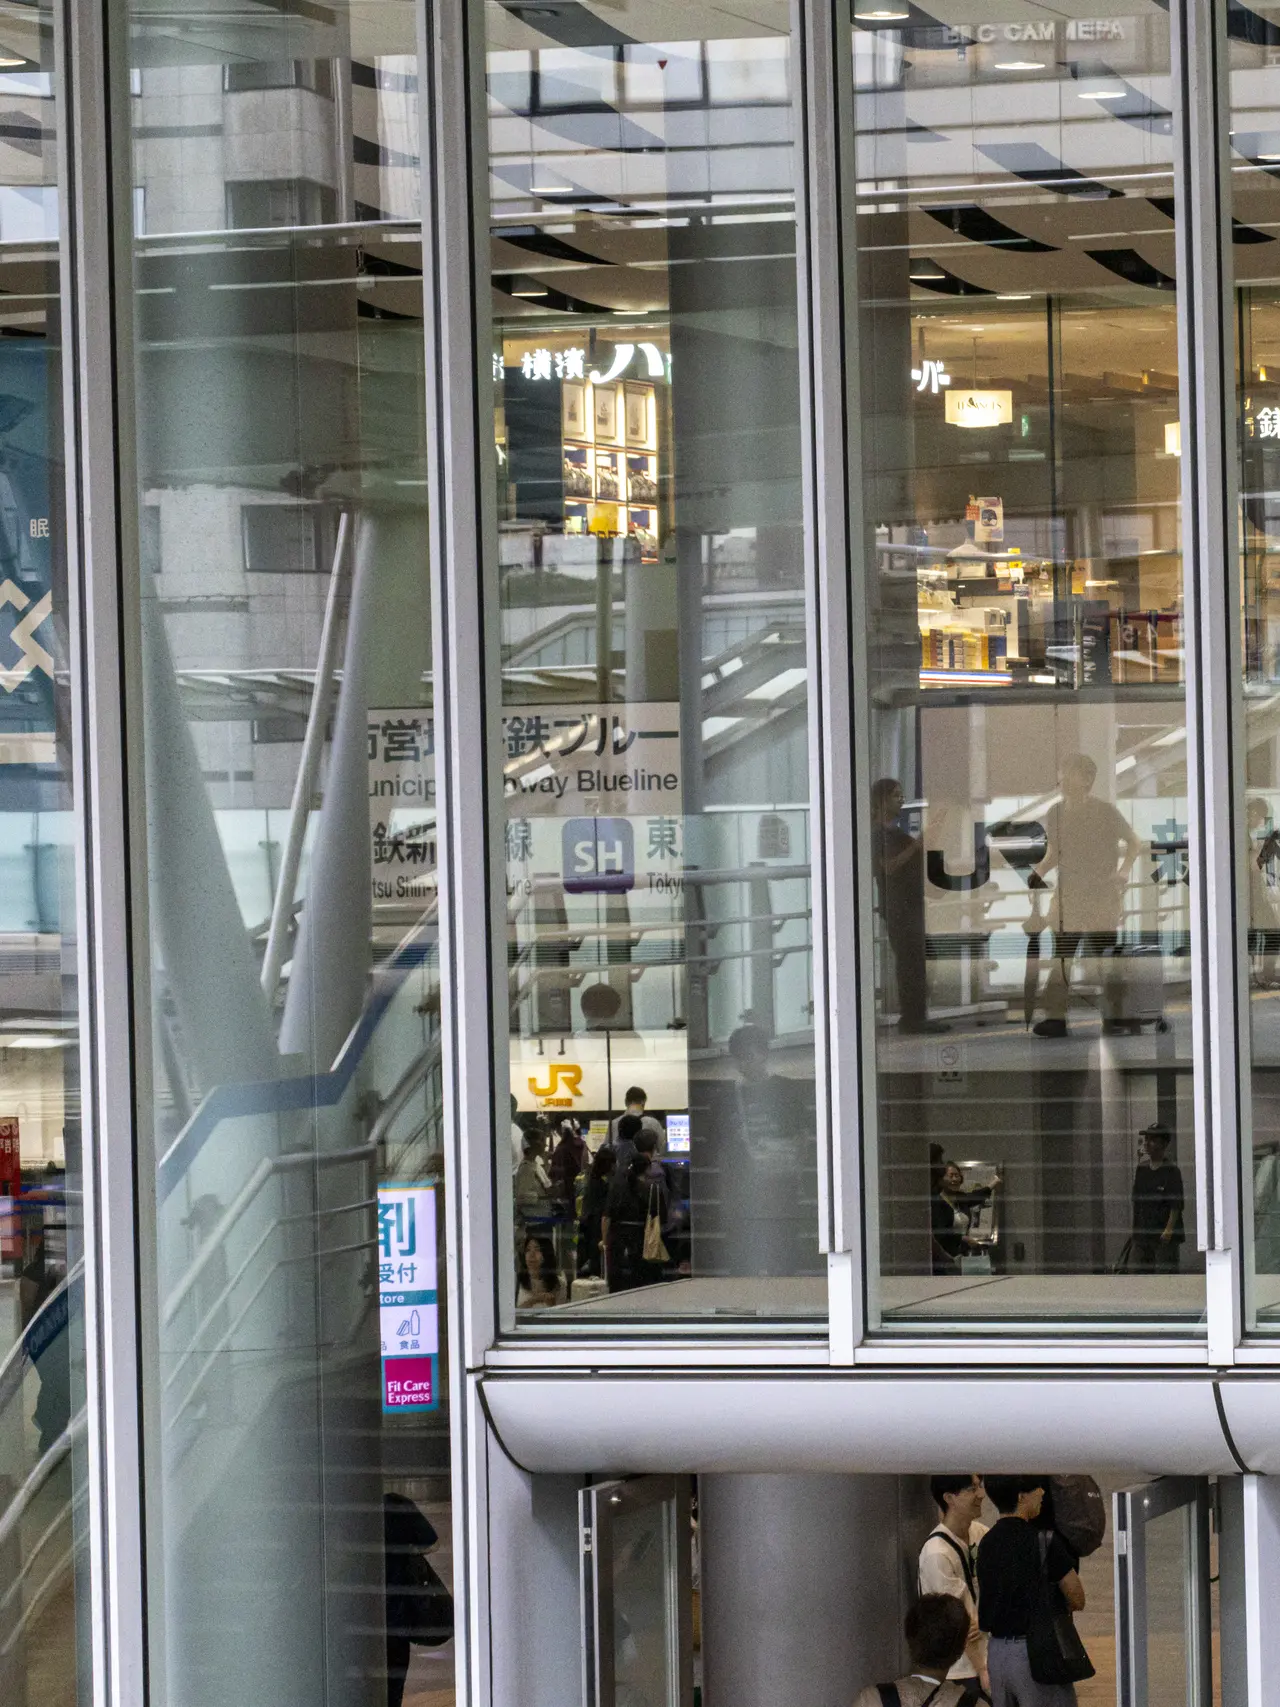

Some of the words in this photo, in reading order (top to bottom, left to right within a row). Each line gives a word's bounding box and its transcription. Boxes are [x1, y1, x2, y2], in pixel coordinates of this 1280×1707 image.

[30, 519, 50, 538] 眠
[578, 769, 679, 793] Blueline
[573, 840, 624, 874] SH
[646, 815, 684, 861] 東
[927, 820, 1049, 891] JR
[396, 875, 437, 898] Shin-
[527, 1064, 583, 1097] JR
[379, 1262, 418, 1285] 受付
[399, 1339, 421, 1350] 食品
[387, 1381, 402, 1393] Fit
[402, 1379, 431, 1392] Care
[387, 1391, 431, 1405] Express
